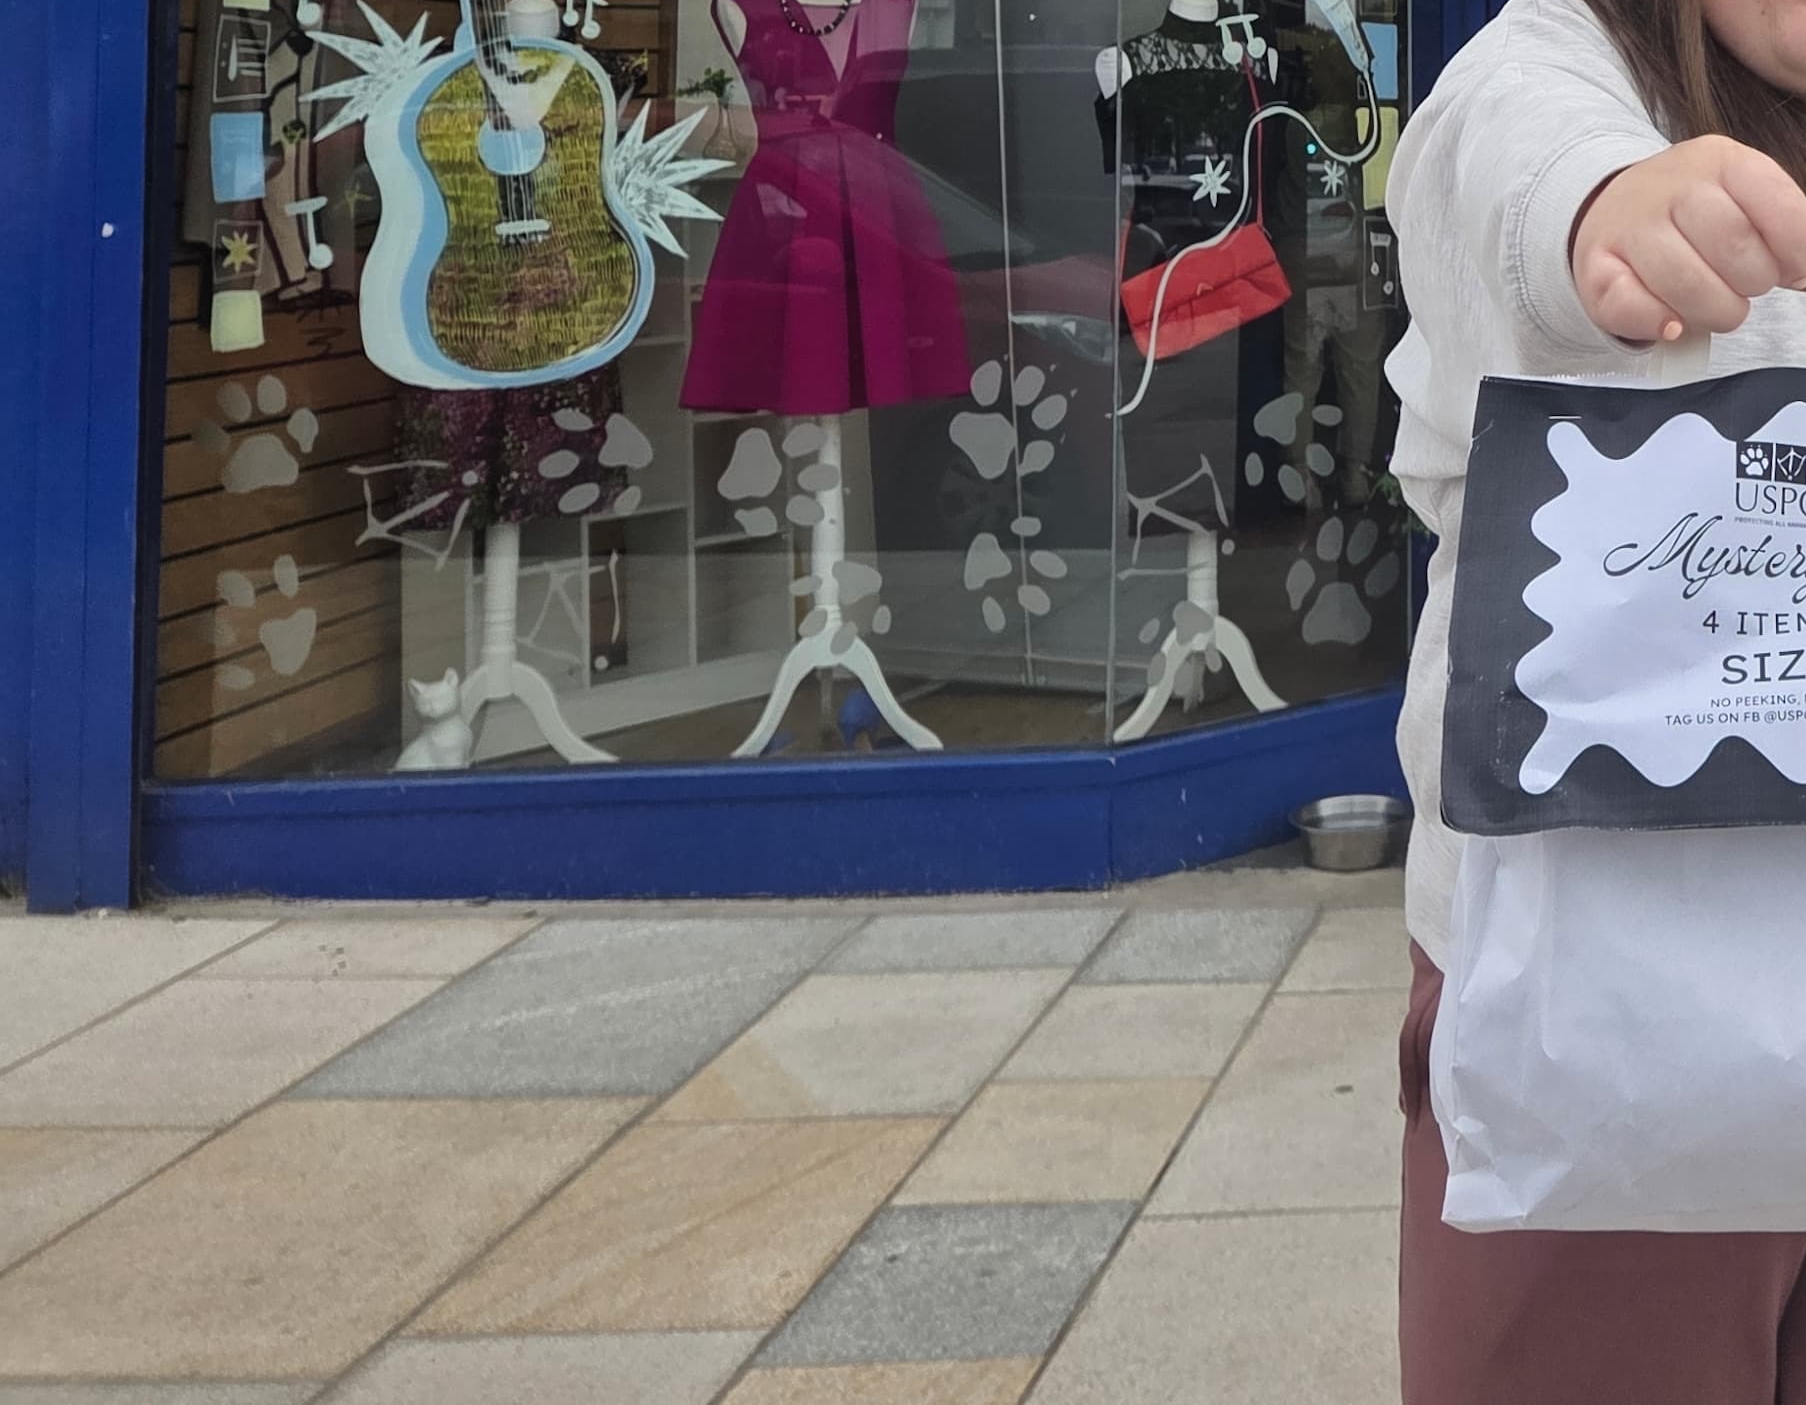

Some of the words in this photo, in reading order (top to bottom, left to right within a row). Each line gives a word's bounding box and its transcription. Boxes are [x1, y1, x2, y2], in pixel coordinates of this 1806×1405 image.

[1701, 609, 1720, 634] 4
[1710, 696, 1731, 708] NO
[1735, 694, 1800, 707] PEEKING,
[1664, 714, 1693, 726] TAG
[1697, 713, 1715, 725] US
[1718, 712, 1740, 724] ON
[1743, 711, 1761, 723] FB
